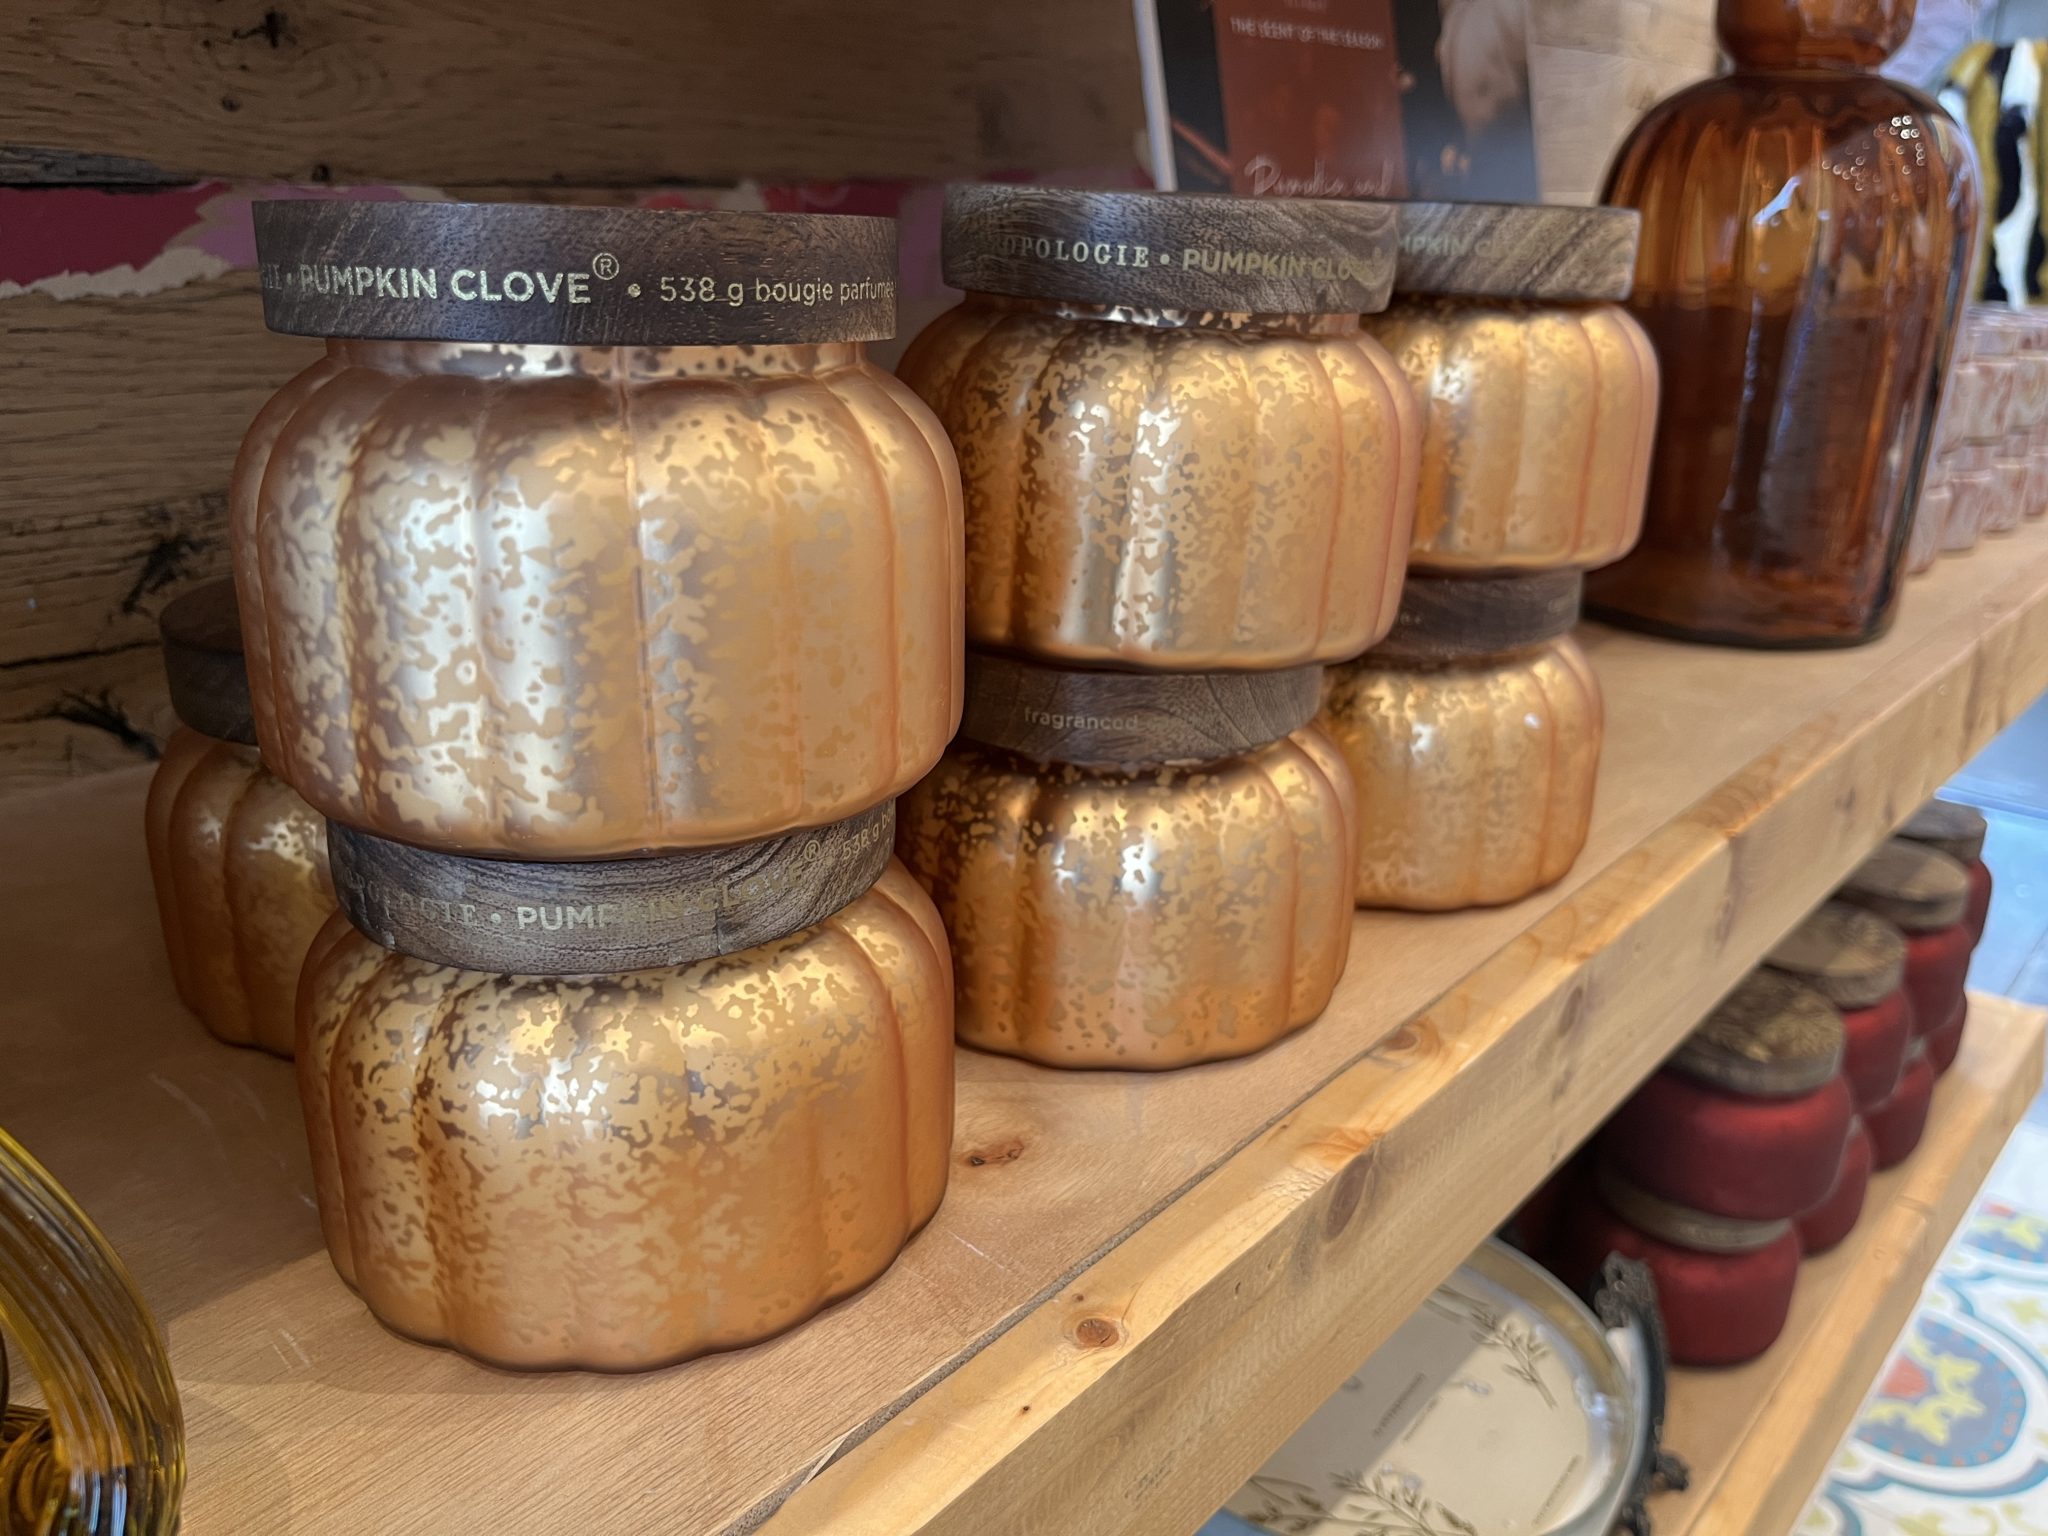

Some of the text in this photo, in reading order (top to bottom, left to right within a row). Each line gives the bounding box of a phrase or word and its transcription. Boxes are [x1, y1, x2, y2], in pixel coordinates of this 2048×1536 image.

[1182, 248, 1306, 279] PUMPKIN
[300, 263, 438, 299] PUMPKIN
[660, 276, 716, 302] 538
[727, 282, 744, 306] g
[755, 277, 834, 306] bougie
[842, 827, 871, 861] 538
